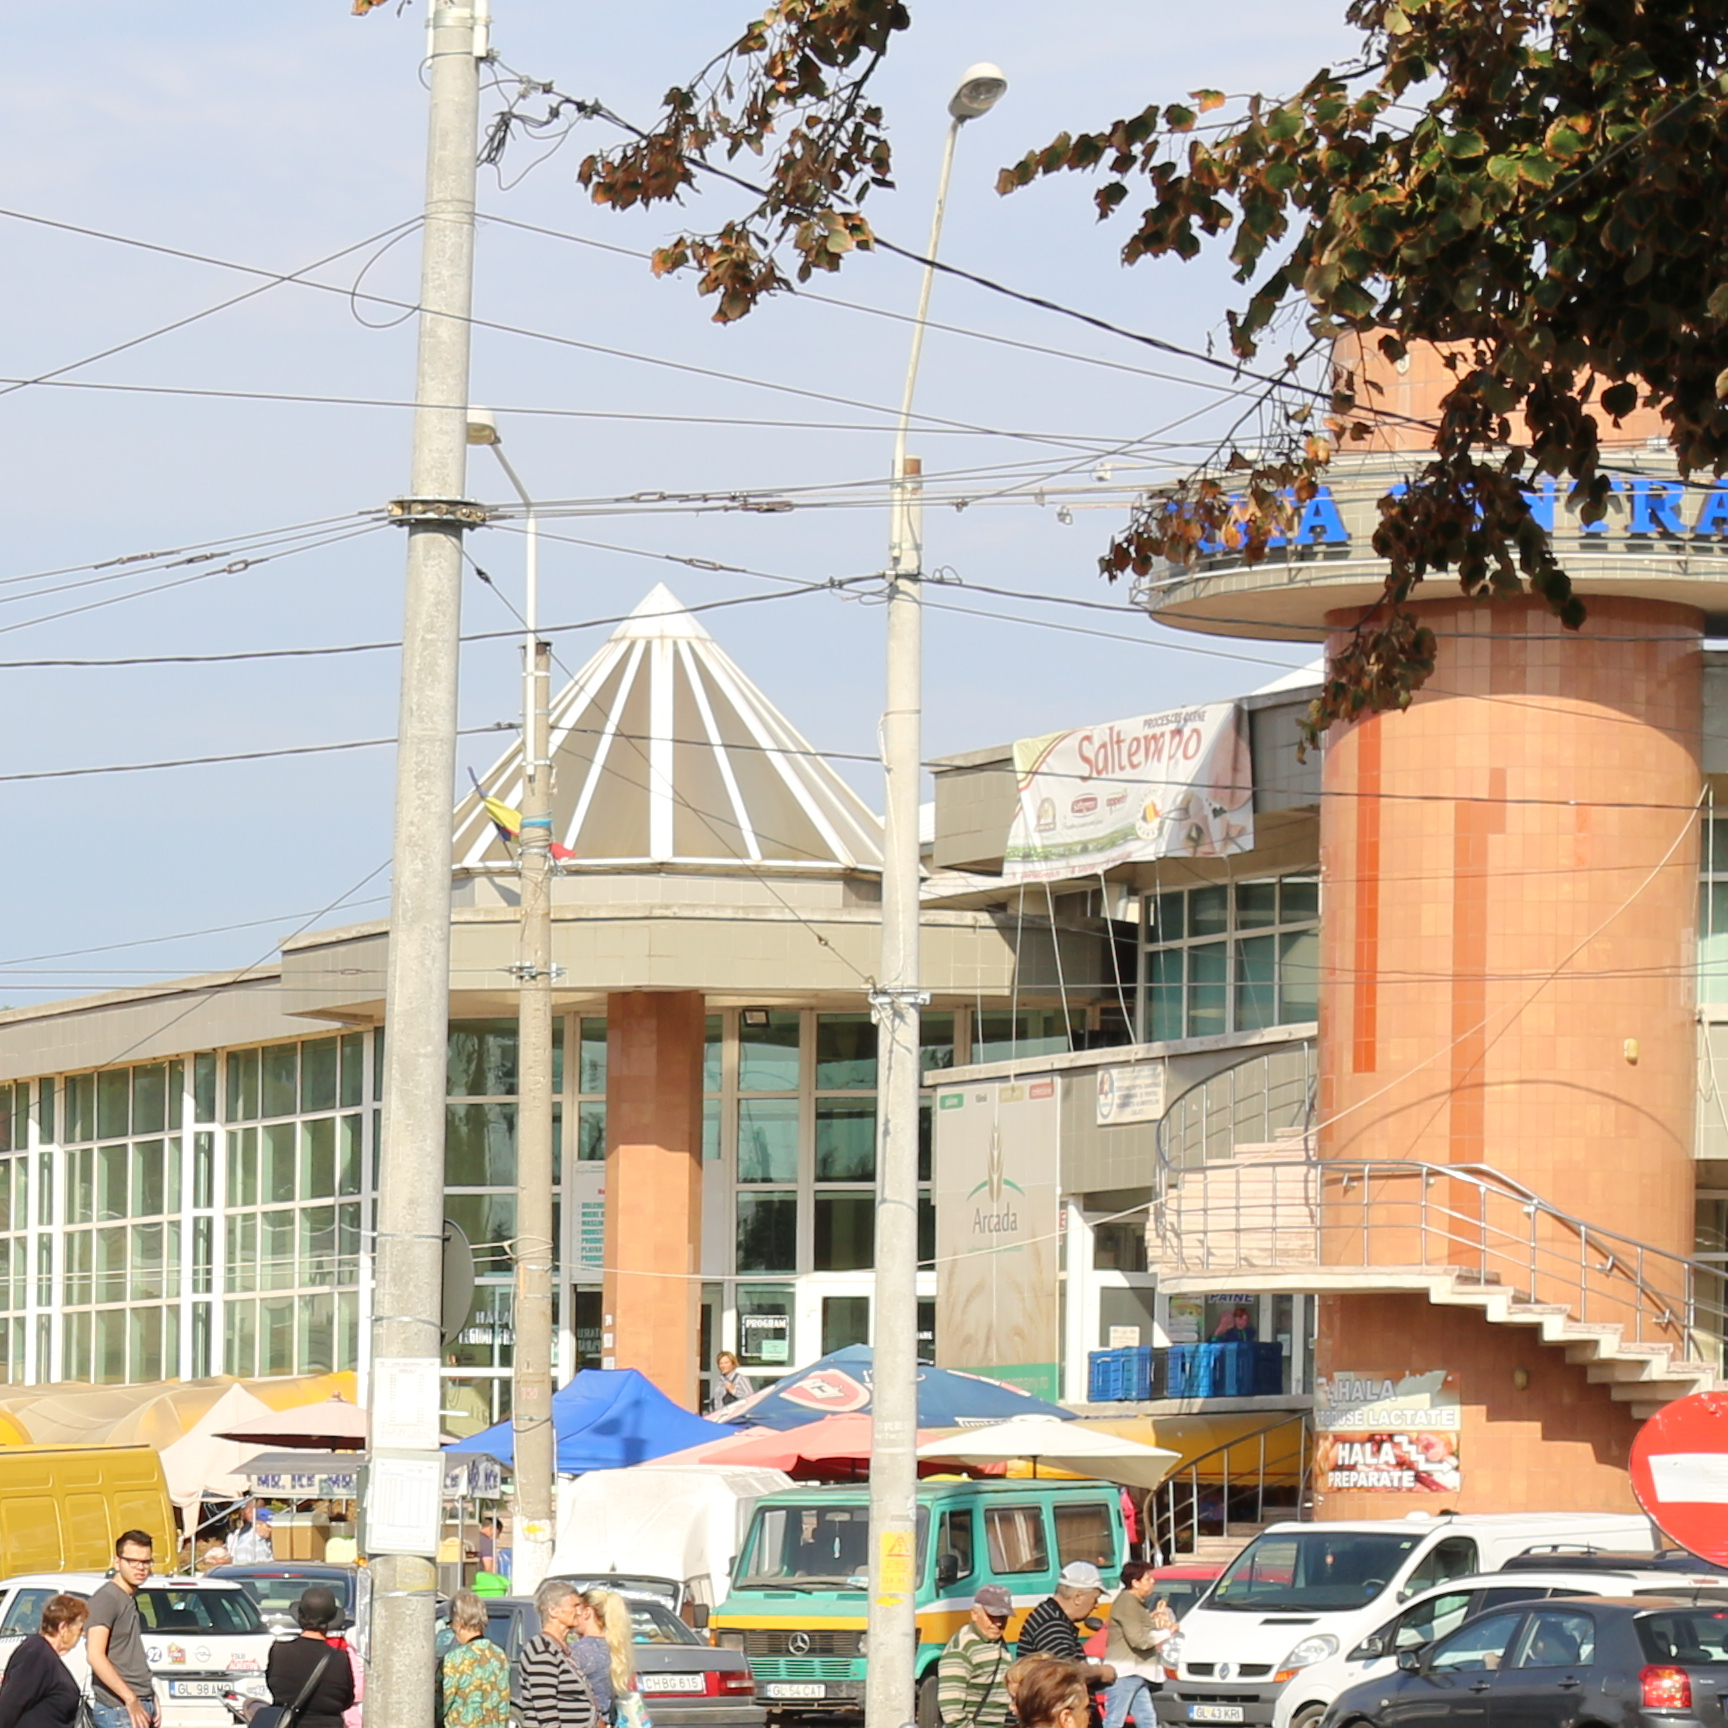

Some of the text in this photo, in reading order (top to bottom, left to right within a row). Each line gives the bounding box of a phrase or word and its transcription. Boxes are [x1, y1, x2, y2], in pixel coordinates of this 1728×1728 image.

[1077, 726, 1203, 783] Saltempo
[973, 1202, 1018, 1234] Arcada
[746, 1319, 787, 1329] PROGRAM
[1339, 1378, 1397, 1402] HALA
[1369, 1409, 1455, 1426] LACTATE
[1337, 1442, 1397, 1465] HALA
[1328, 1471, 1416, 1488] PREPARATE
[148, 1648, 161, 1661] 92
[178, 1684, 192, 1695] GL
[197, 1684, 209, 1695] 98
[646, 1677, 676, 1690] CHBG
[772, 1687, 823, 1697] GL 54 CAT
[1196, 1707, 1240, 1719] GL 43 KRI
